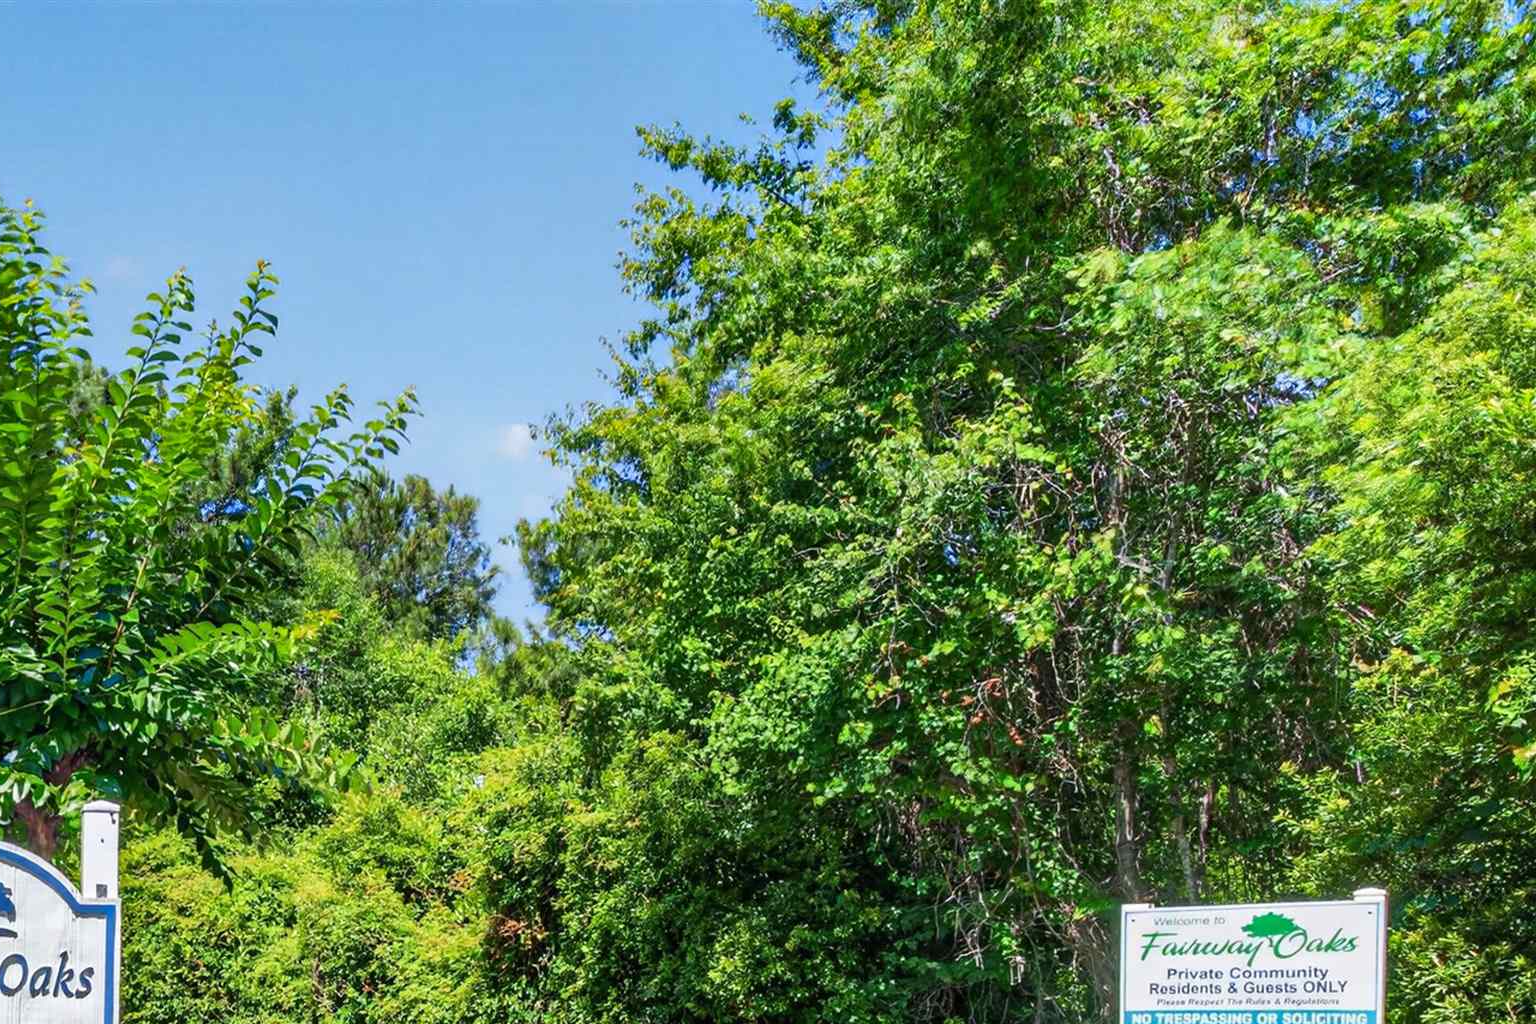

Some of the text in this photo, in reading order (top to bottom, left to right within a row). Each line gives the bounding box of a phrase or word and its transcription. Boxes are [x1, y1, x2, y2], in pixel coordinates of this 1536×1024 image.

[1154, 916, 1226, 926] Welcome to
[1140, 926, 1359, 967] Fairway Oaks
[1167, 966, 1329, 980] Private Community
[1149, 980, 1348, 995] Residents & Guests ONLY
[1131, 1013, 1152, 1024] NO
